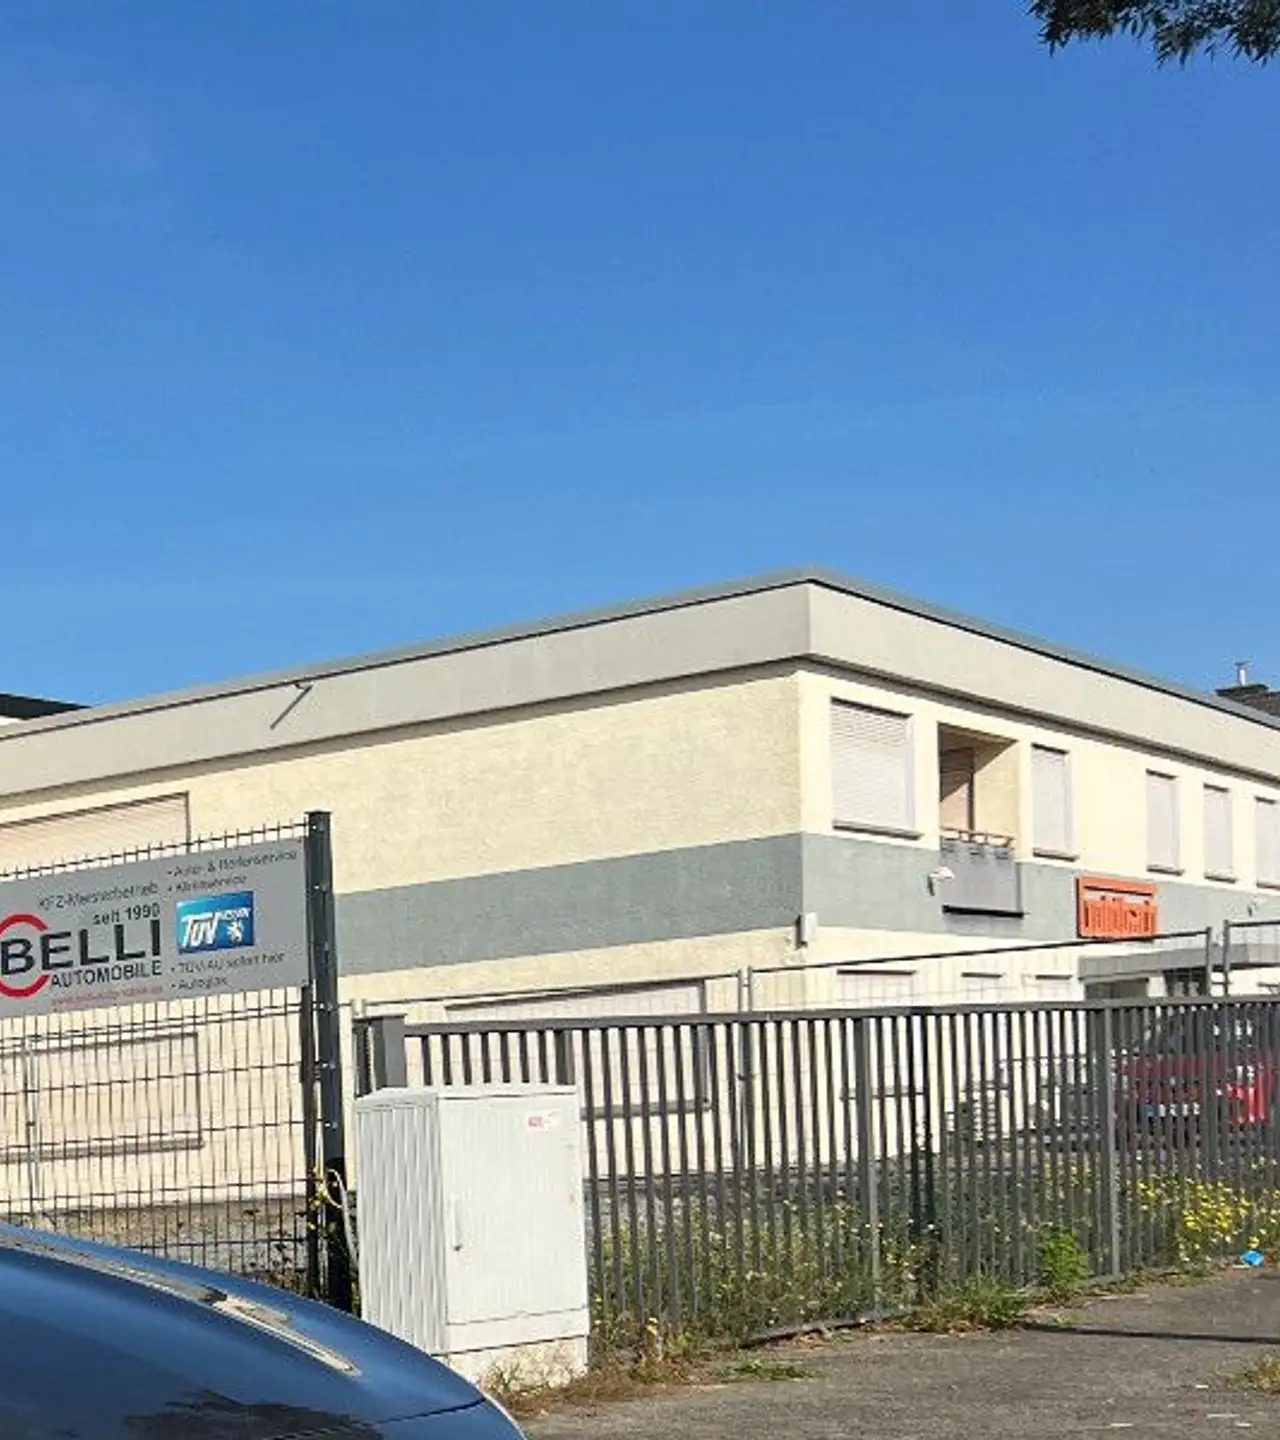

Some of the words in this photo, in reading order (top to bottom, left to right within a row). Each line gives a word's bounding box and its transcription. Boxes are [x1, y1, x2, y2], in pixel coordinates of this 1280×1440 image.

[92, 909, 121, 926] seit
[125, 902, 161, 921] 1990
[1, 919, 161, 976] BELLI
[51, 959, 163, 988] AUTOMOBILE
